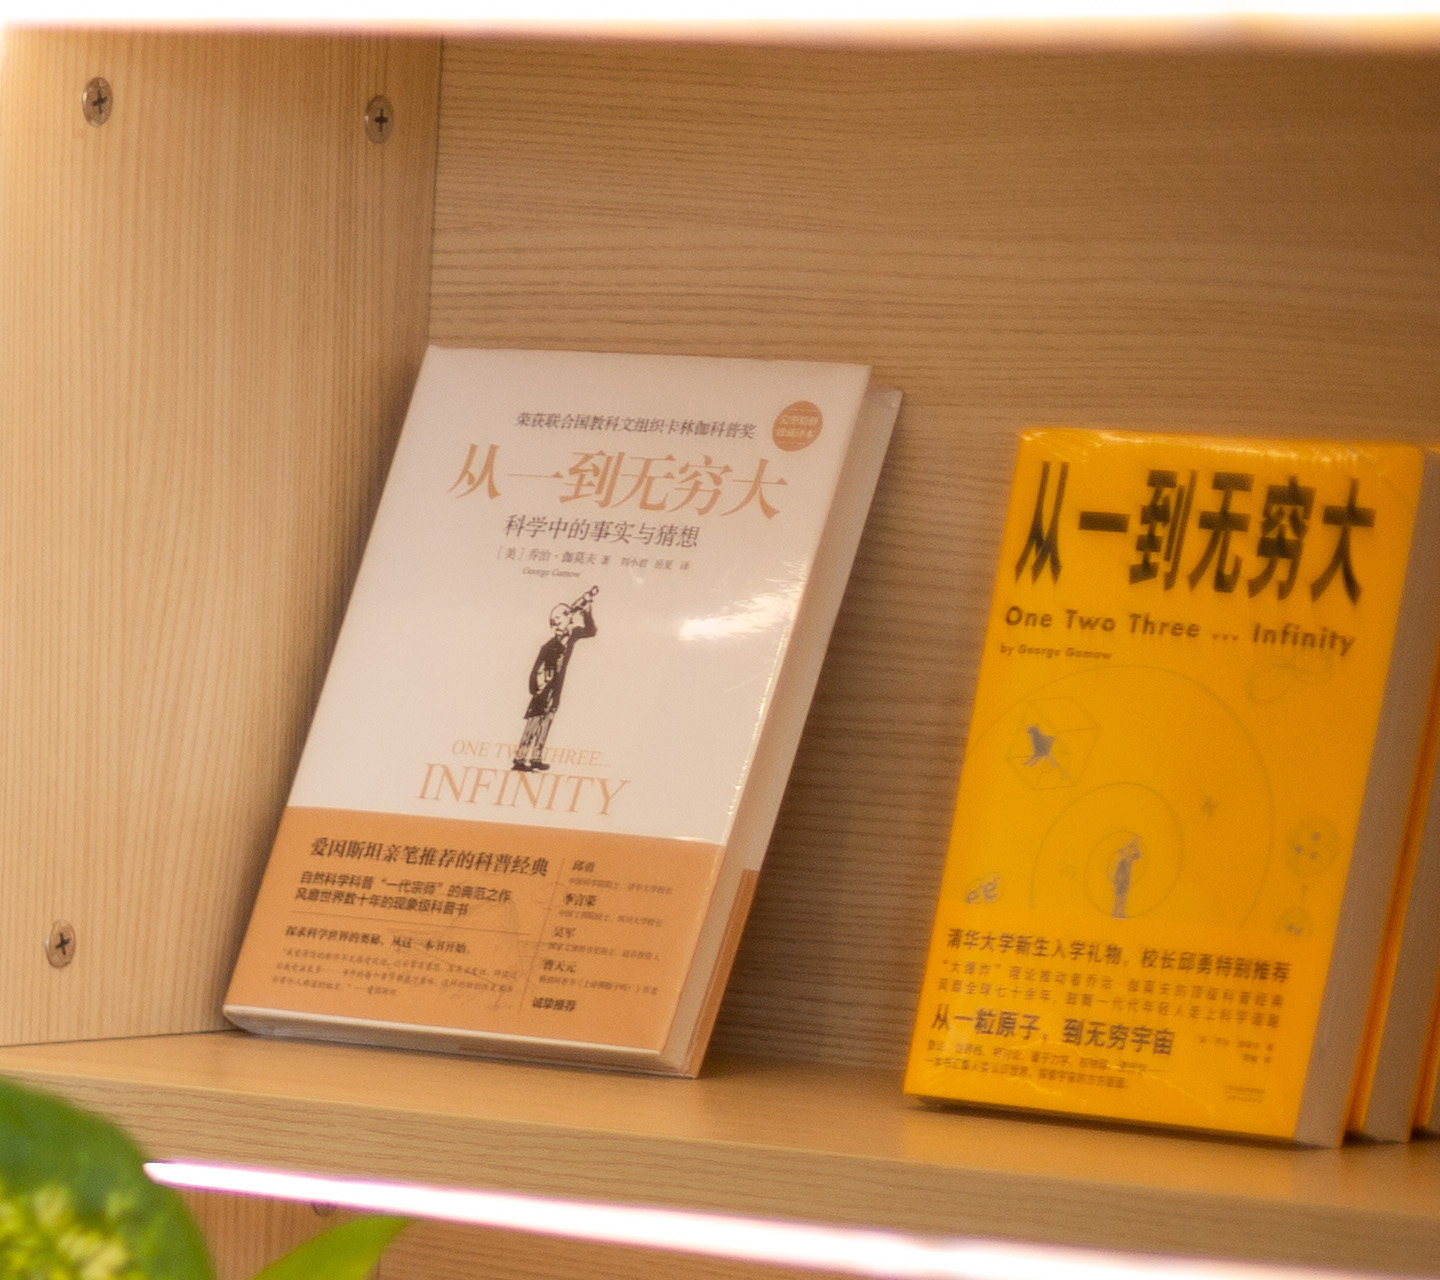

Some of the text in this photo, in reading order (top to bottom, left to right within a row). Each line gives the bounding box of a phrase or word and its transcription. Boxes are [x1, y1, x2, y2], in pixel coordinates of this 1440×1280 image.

[514, 410, 757, 440] 荣获联合国教科文组织卡林伽科普奖
[447, 442, 788, 520] 从一到无穷大
[504, 513, 701, 550] 科学中的事实与猜想
[1015, 460, 1377, 605] 从一到无穷大
[1000, 642, 1014, 656] by
[1005, 605, 1053, 628] One
[1065, 608, 1117, 632] Two
[1129, 613, 1200, 639] Three
[1252, 621, 1356, 658] Infinity
[452, 739, 491, 758] ONE
[416, 762, 631, 816] INFINITY
[309, 837, 549, 879] 爱因斯坦亲笔推荐的科普经典
[947, 927, 1292, 985] 清华大学新生入学礼物，校长邱勇特别推荐
[930, 1002, 1176, 1057] 从一粒原子，到无穷宇宙
